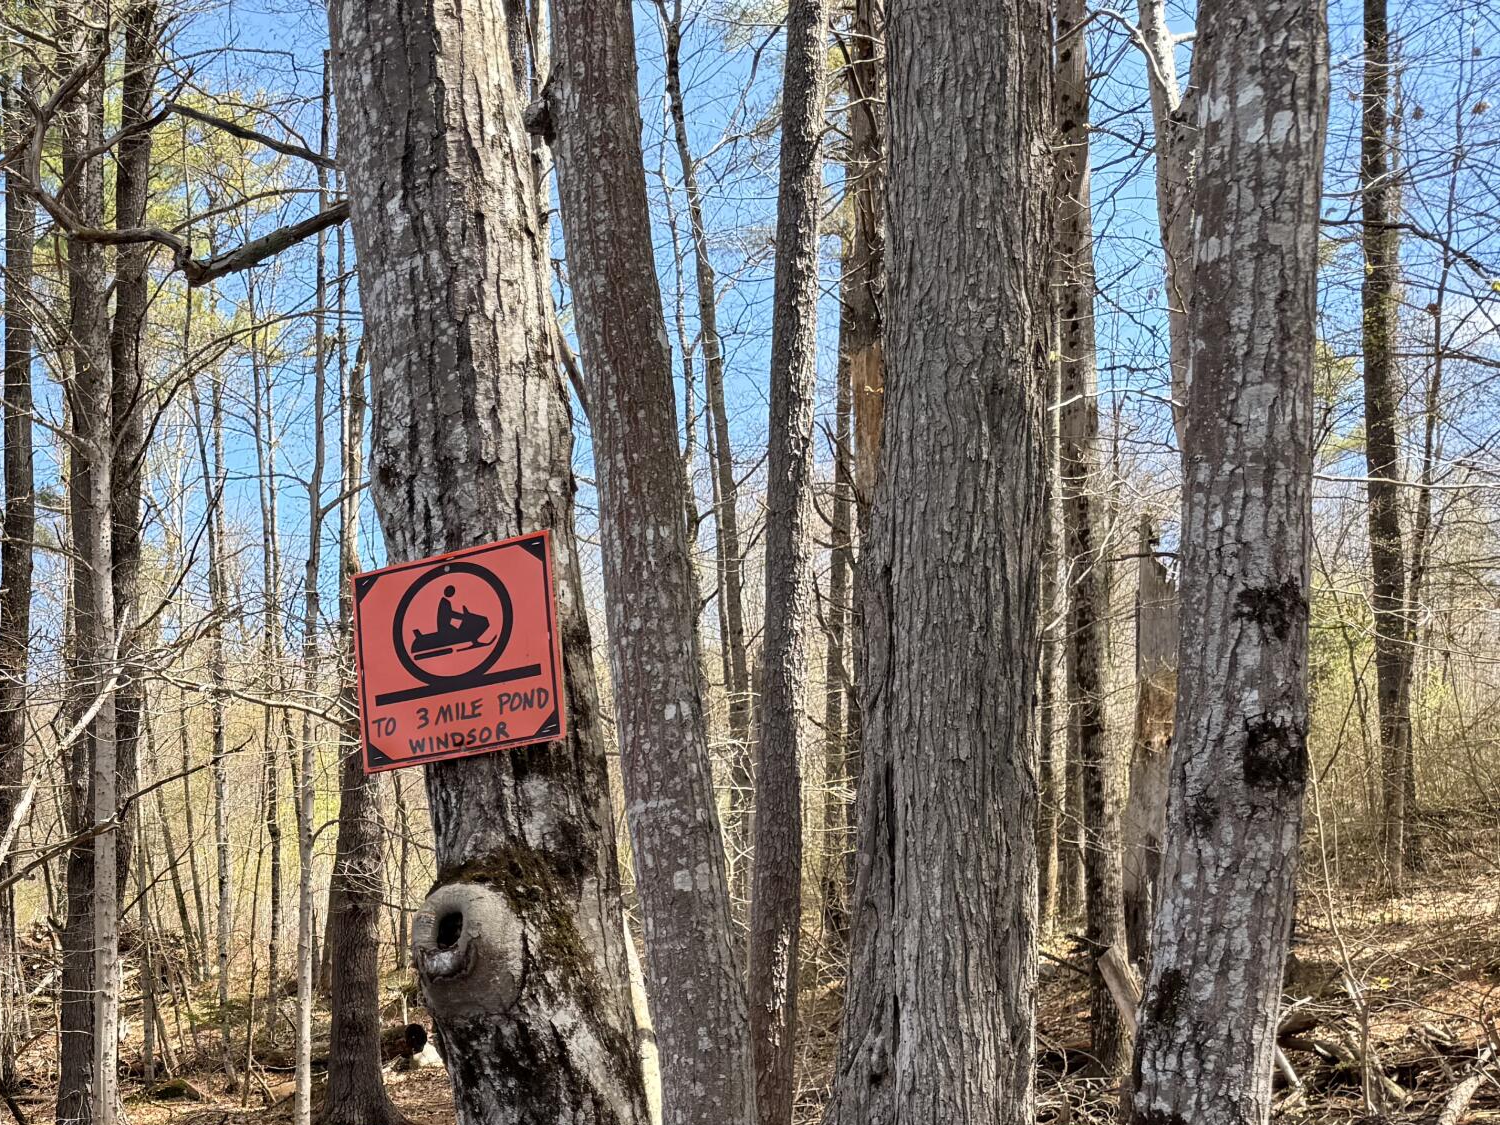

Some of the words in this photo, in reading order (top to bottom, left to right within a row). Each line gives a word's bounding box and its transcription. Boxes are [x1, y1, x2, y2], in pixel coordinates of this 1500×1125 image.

[372, 716, 396, 738] TO
[415, 707, 429, 729] 3
[435, 698, 483, 726] MILE
[498, 687, 549, 715] POND
[408, 721, 509, 754] WINDSOR
